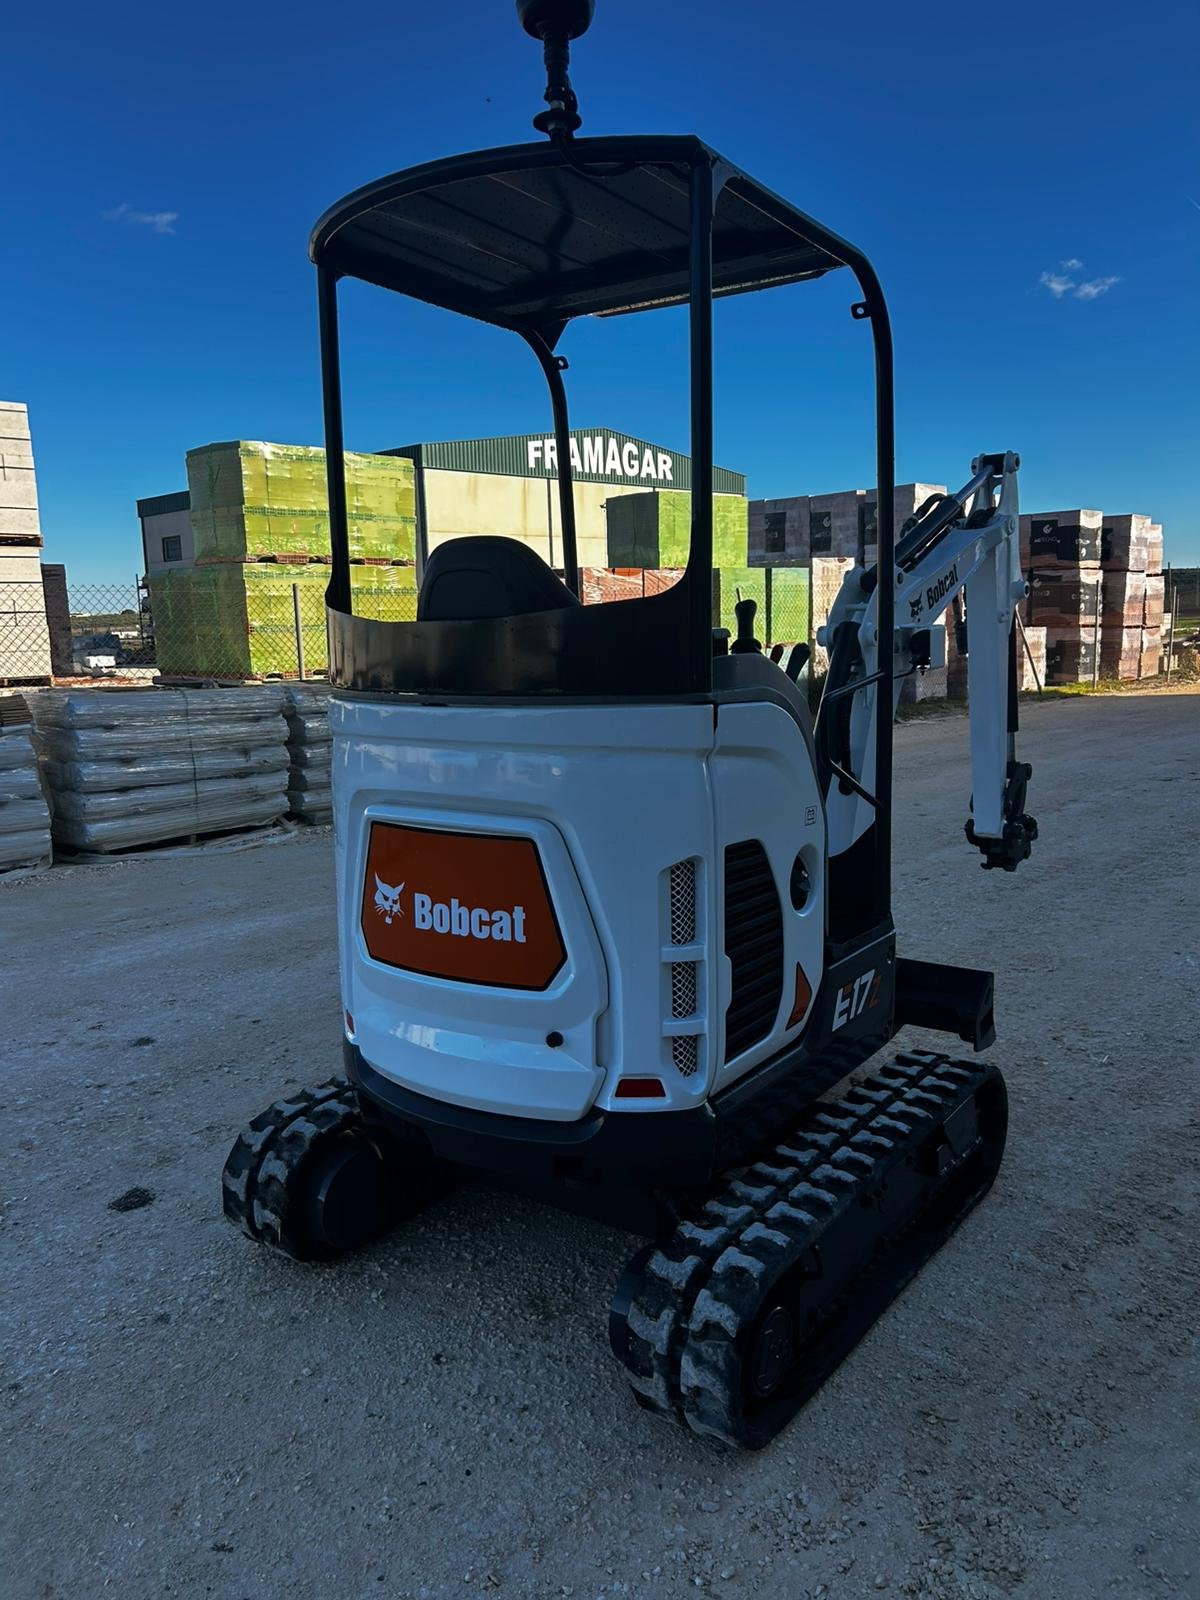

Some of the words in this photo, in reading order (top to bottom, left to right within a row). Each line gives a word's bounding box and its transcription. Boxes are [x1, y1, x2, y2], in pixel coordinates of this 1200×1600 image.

[527, 436, 674, 481] FRAMAGAR
[926, 563, 959, 610] Bobcat
[414, 892, 527, 943] Bobcat
